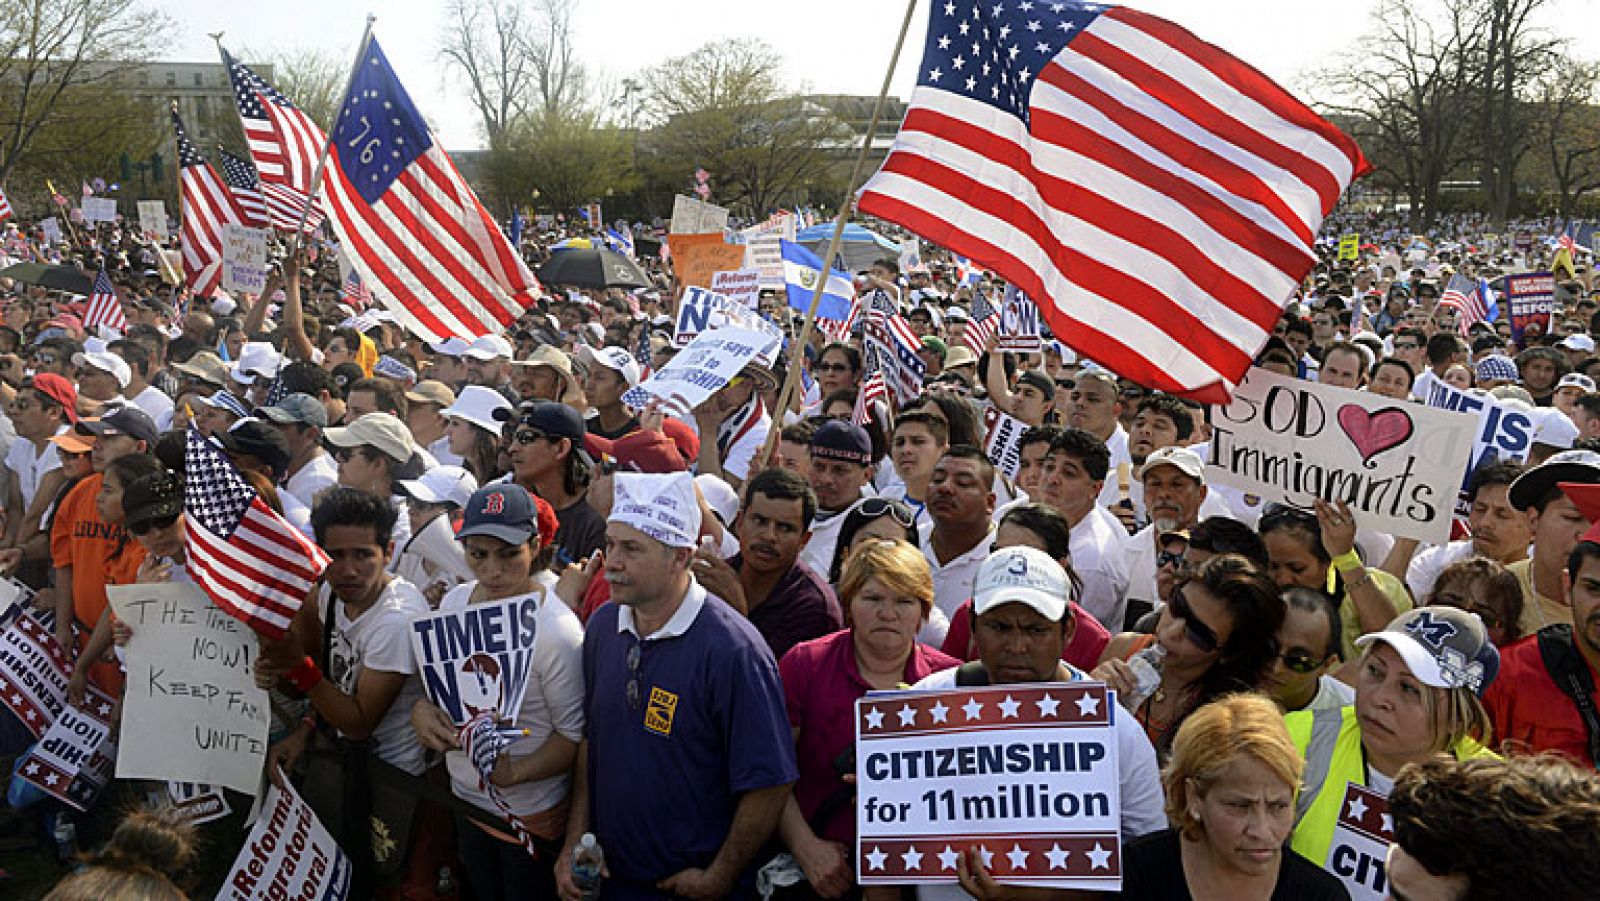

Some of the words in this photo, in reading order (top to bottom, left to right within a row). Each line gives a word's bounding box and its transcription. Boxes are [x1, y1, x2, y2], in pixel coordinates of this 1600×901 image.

[349, 116, 382, 164] 76
[1481, 405, 1531, 452] IS
[1208, 428, 1436, 522] Immigrants
[481, 492, 504, 515] B
[124, 599, 197, 624] THE
[414, 606, 507, 664] TIME
[507, 598, 537, 650] IS
[193, 637, 250, 676] NOW!
[150, 664, 220, 702] KEEP
[866, 742, 1106, 781] CITIZENSHIP
[864, 796, 911, 823] for
[922, 789, 957, 821] 11
[962, 783, 1111, 820] million
[1333, 845, 1387, 894] CIT
